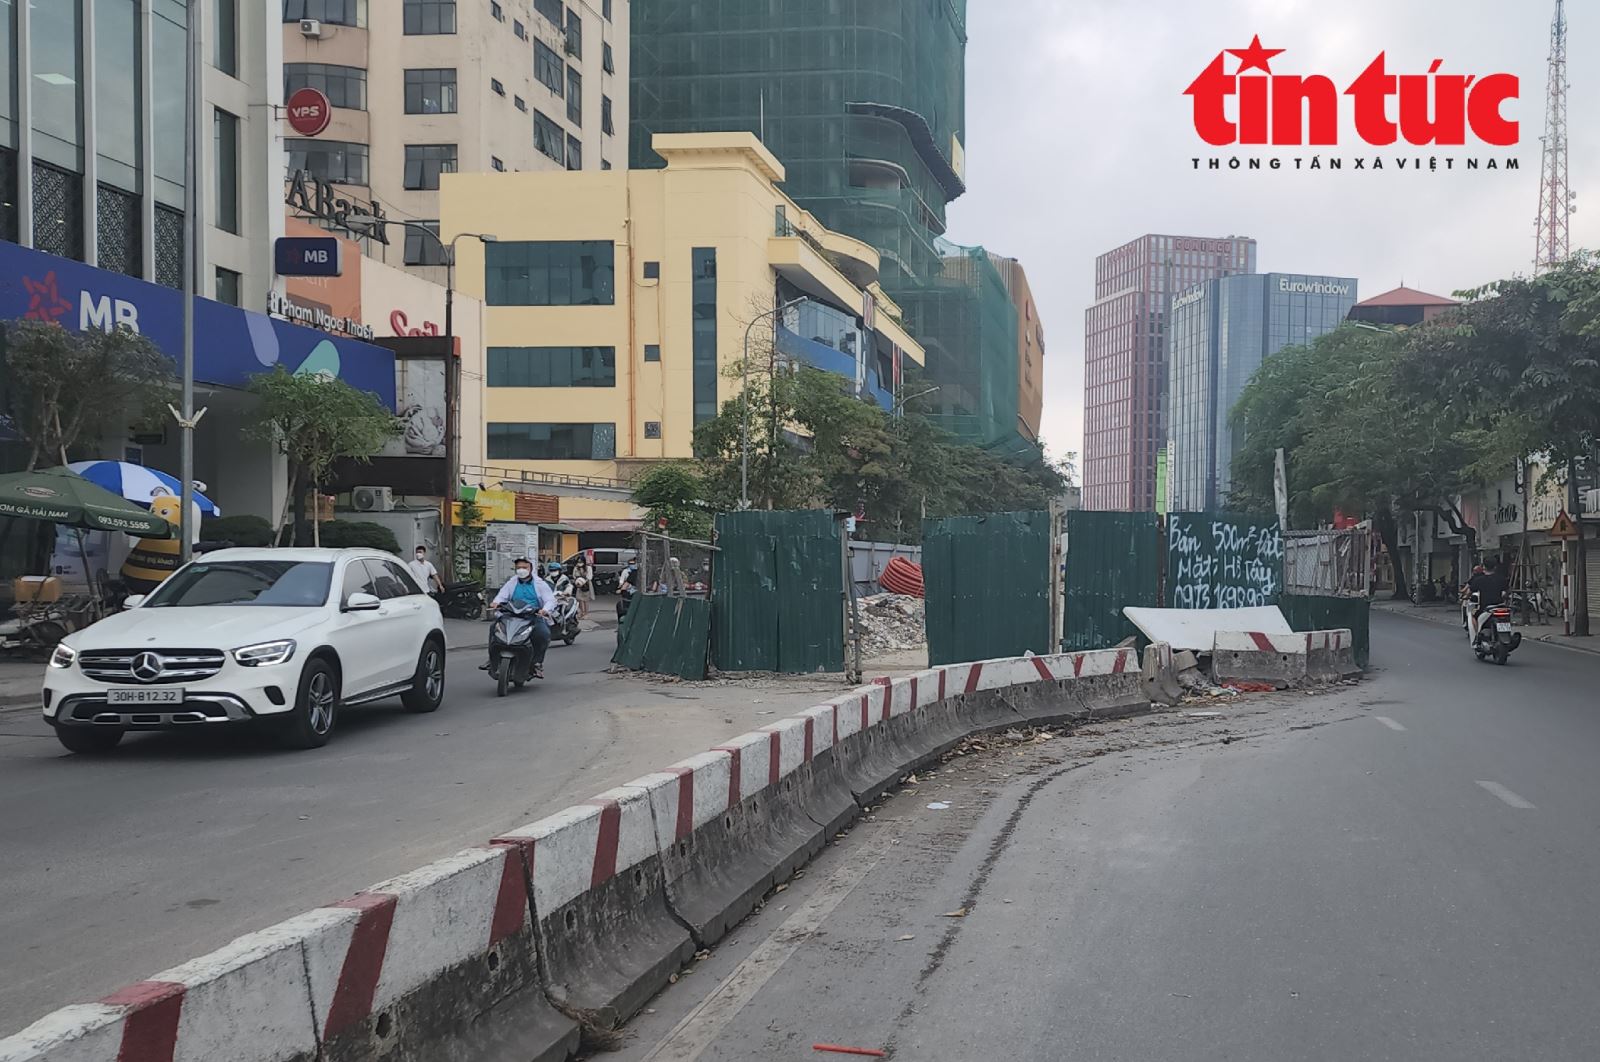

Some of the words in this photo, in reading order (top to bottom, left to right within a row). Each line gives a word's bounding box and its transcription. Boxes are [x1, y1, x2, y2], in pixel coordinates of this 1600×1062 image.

[292, 105, 320, 118] VPS
[304, 250, 328, 263] MB
[1279, 277, 1349, 296] Eurowindow
[80, 289, 140, 337] MB
[47, 510, 69, 518] NAM
[112, 691, 177, 702] 30H-812.32
